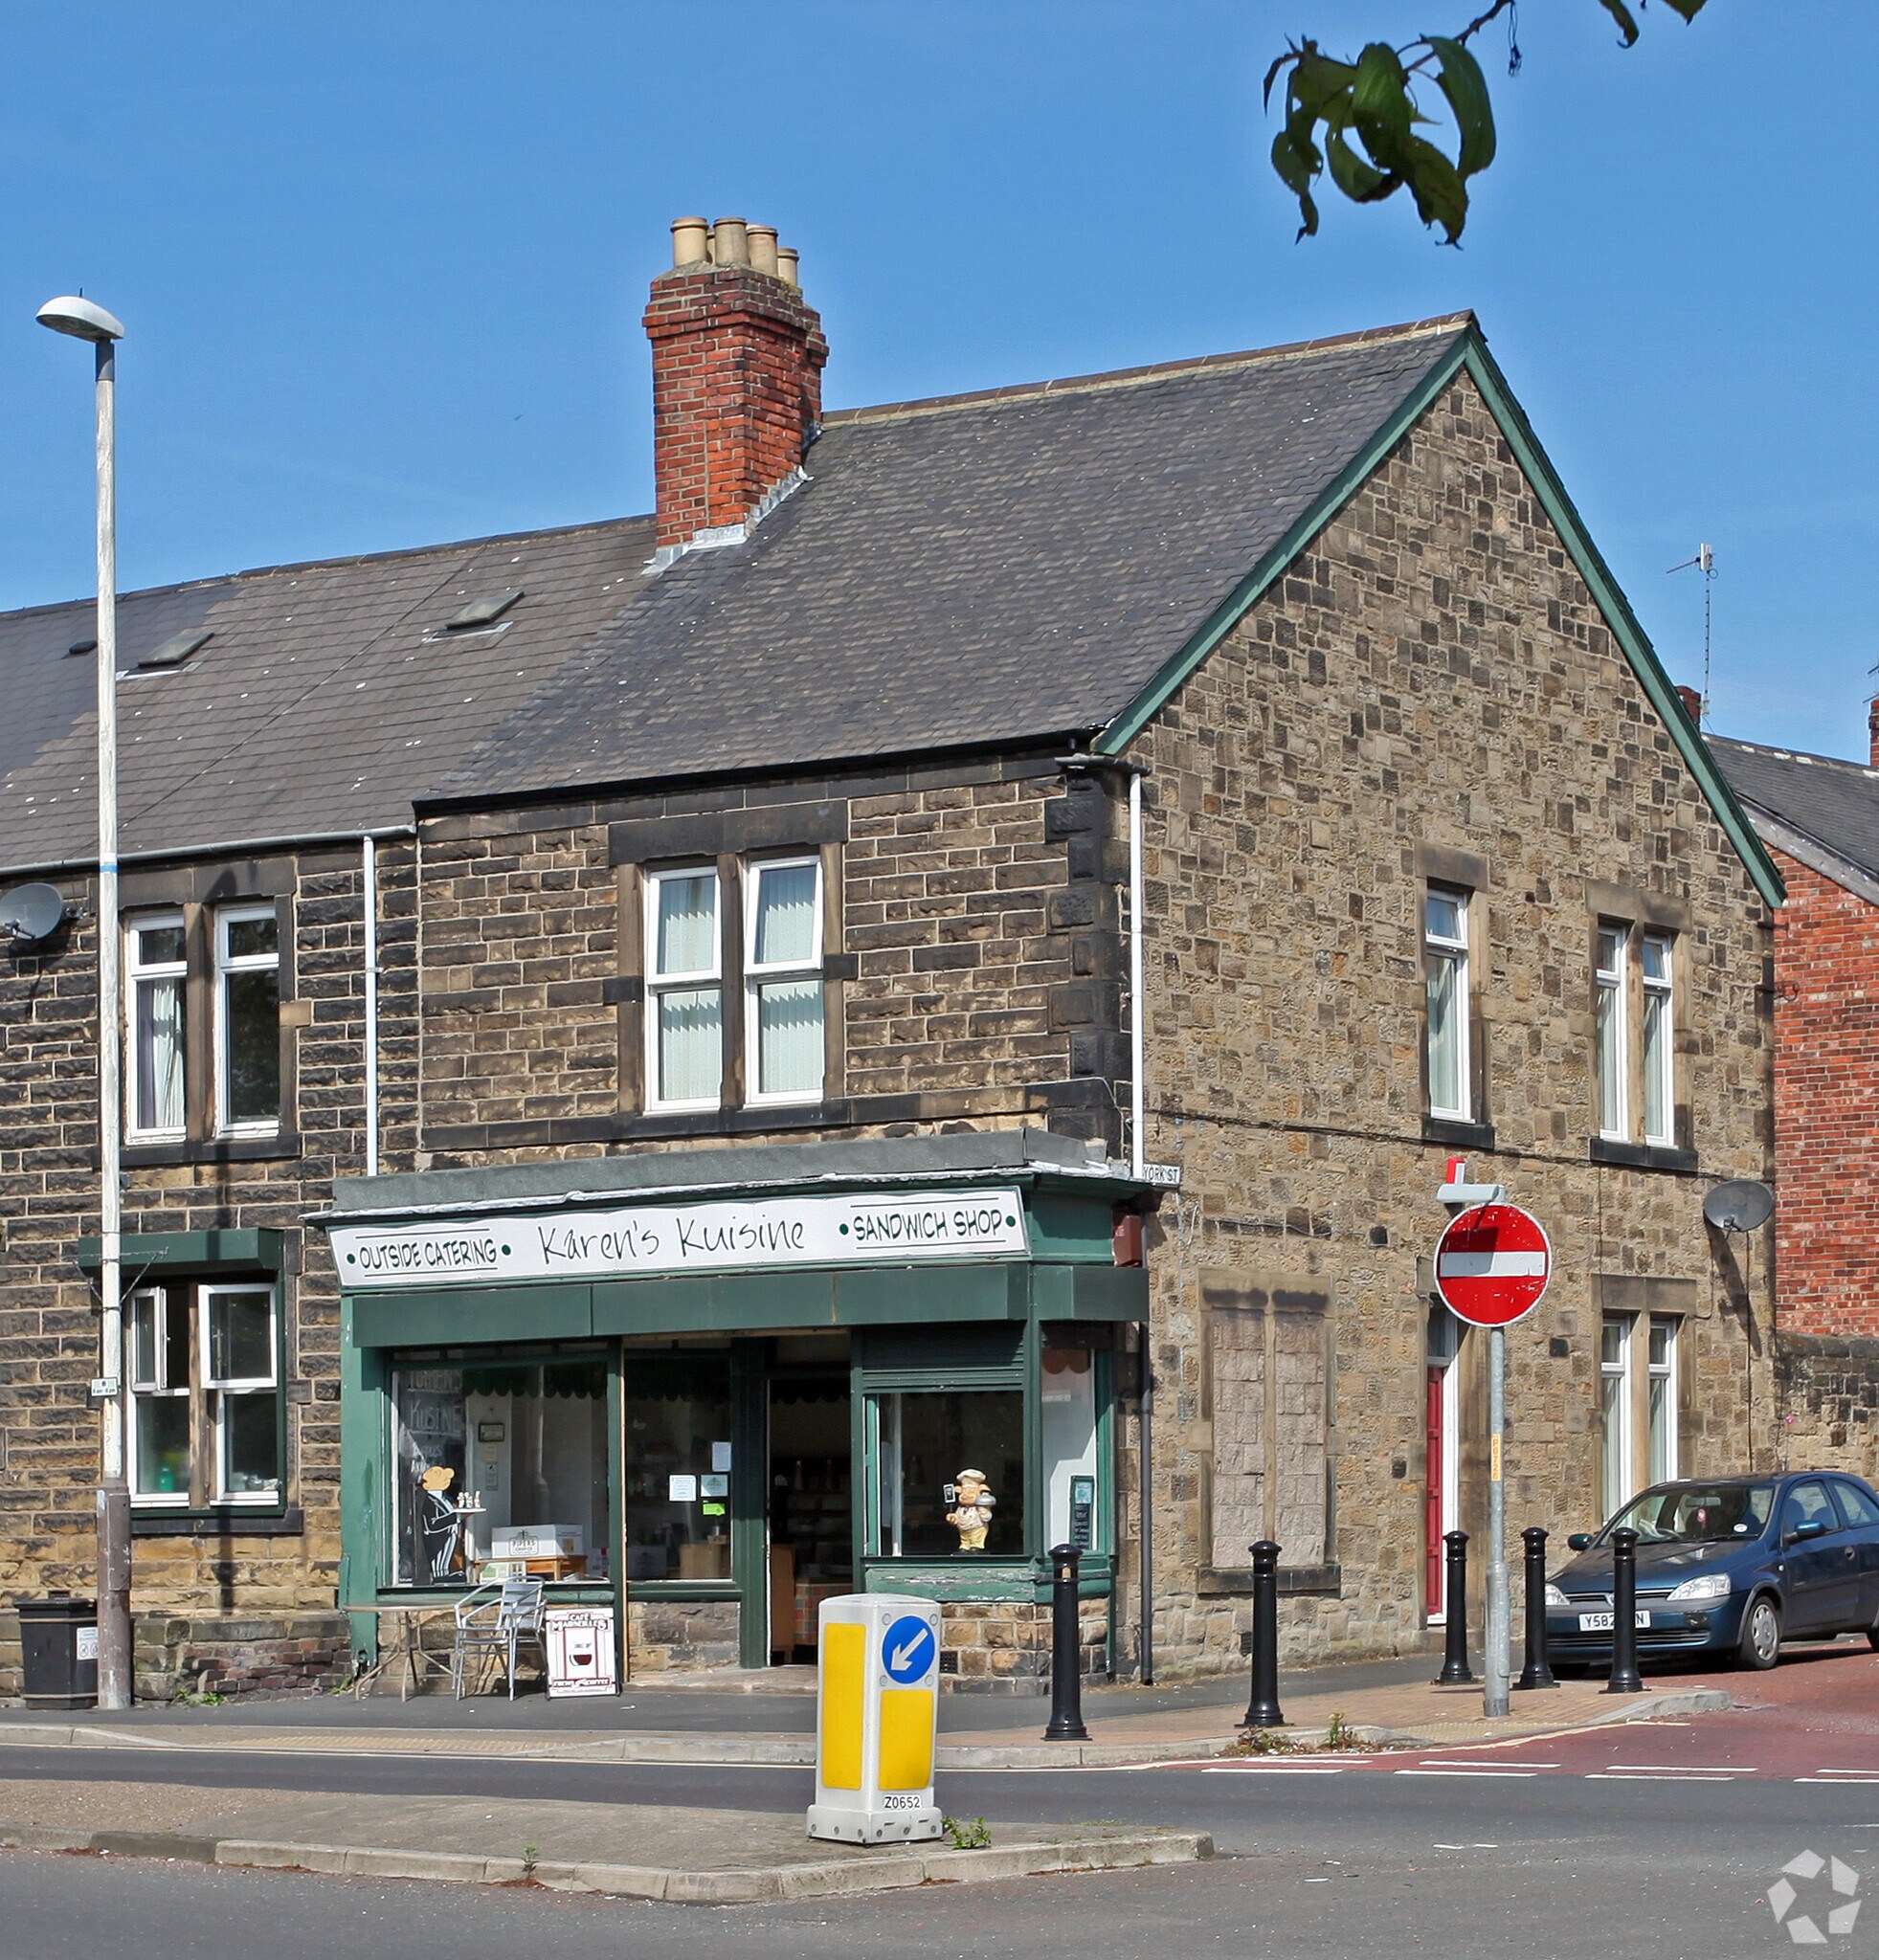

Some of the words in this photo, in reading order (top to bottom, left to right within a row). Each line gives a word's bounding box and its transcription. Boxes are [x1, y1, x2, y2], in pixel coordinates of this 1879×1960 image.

[1168, 1169, 1178, 1183] ST
[538, 1219, 659, 1265] Karen's
[676, 1214, 805, 1258] Kuisine
[853, 1212, 949, 1241] SANDWICH
[953, 1209, 1002, 1236] SHOP
[359, 1242, 421, 1270] OUTSIDE
[424, 1238, 497, 1266] CATERING
[884, 1795, 921, 1809] Z0652
